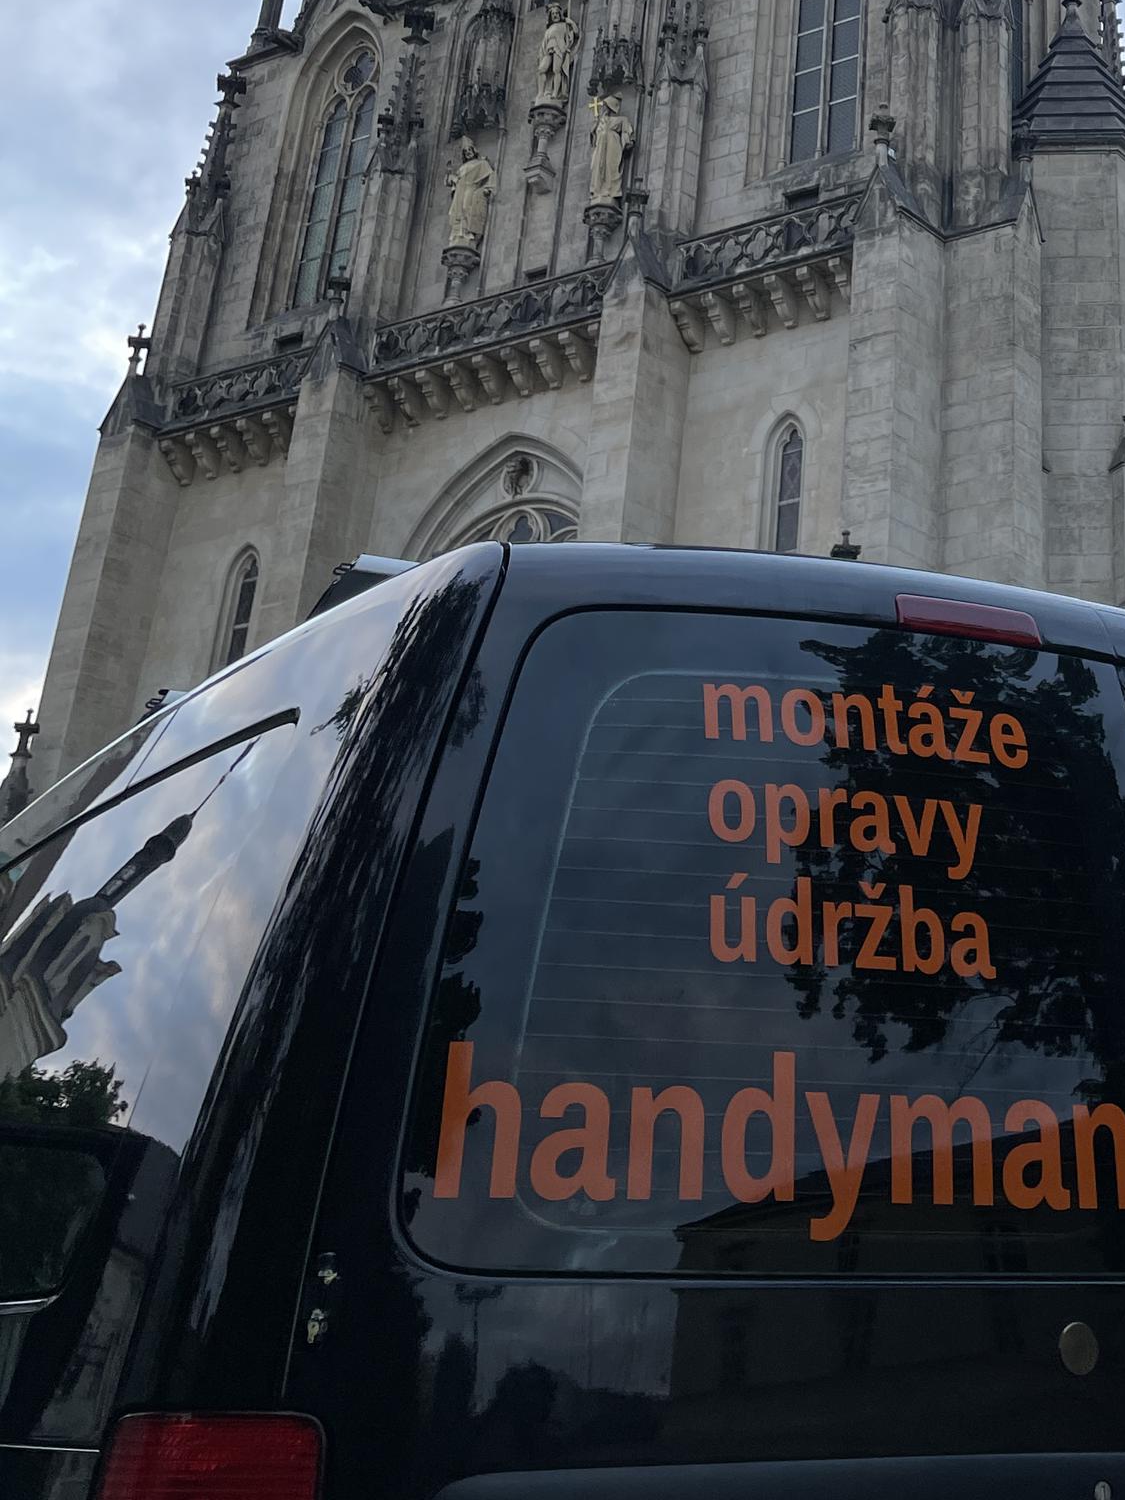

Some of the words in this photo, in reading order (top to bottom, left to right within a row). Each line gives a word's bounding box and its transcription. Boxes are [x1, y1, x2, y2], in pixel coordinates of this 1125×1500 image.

[702, 682, 1029, 769] montáže
[708, 779, 982, 880] opravy
[709, 872, 997, 979] údržba
